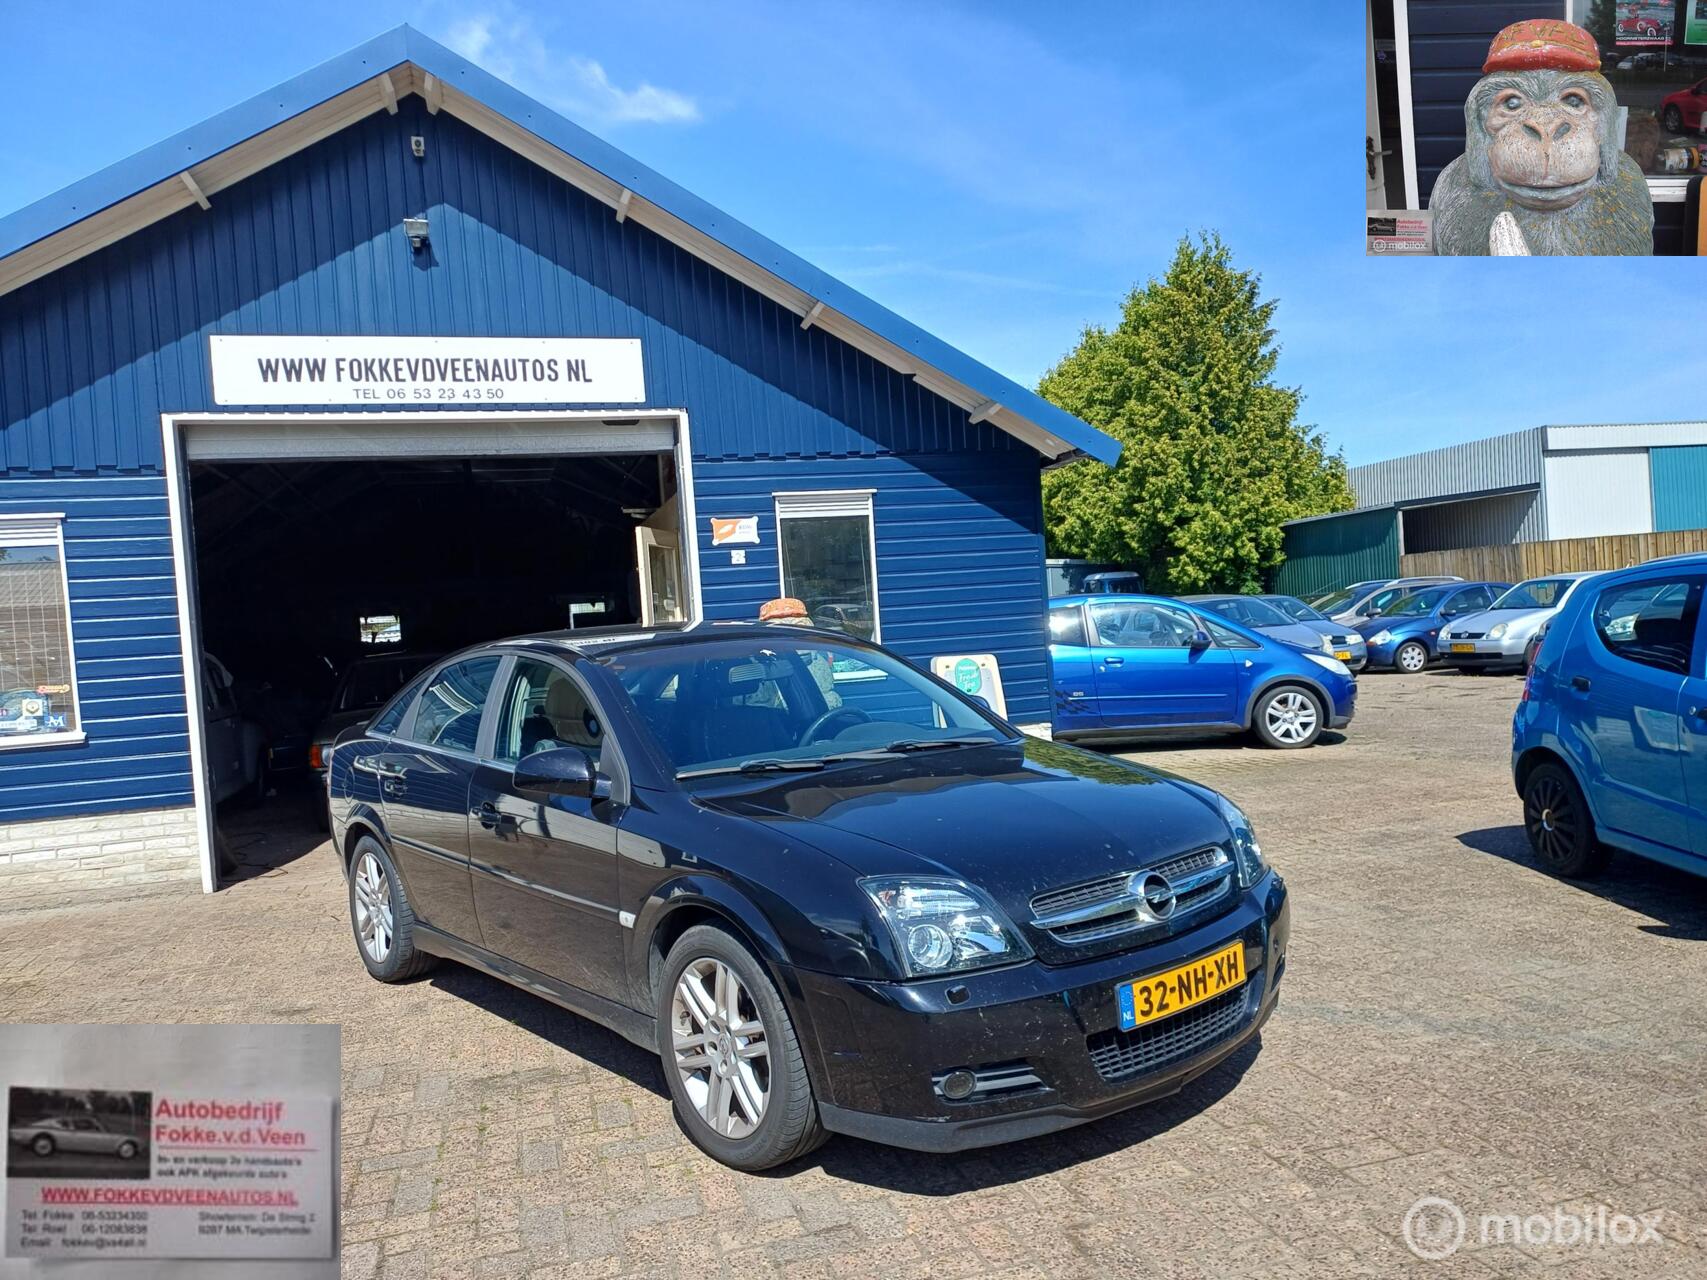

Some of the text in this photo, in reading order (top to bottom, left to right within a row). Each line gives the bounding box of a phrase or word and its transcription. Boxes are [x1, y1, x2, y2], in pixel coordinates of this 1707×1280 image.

[257, 357, 592, 383] WWW FOKKEVDVEENAUTOS NL
[353, 388, 504, 401] TEL 06 53 23 43 50
[1123, 951, 1239, 1022] NL 32-NH-XH
